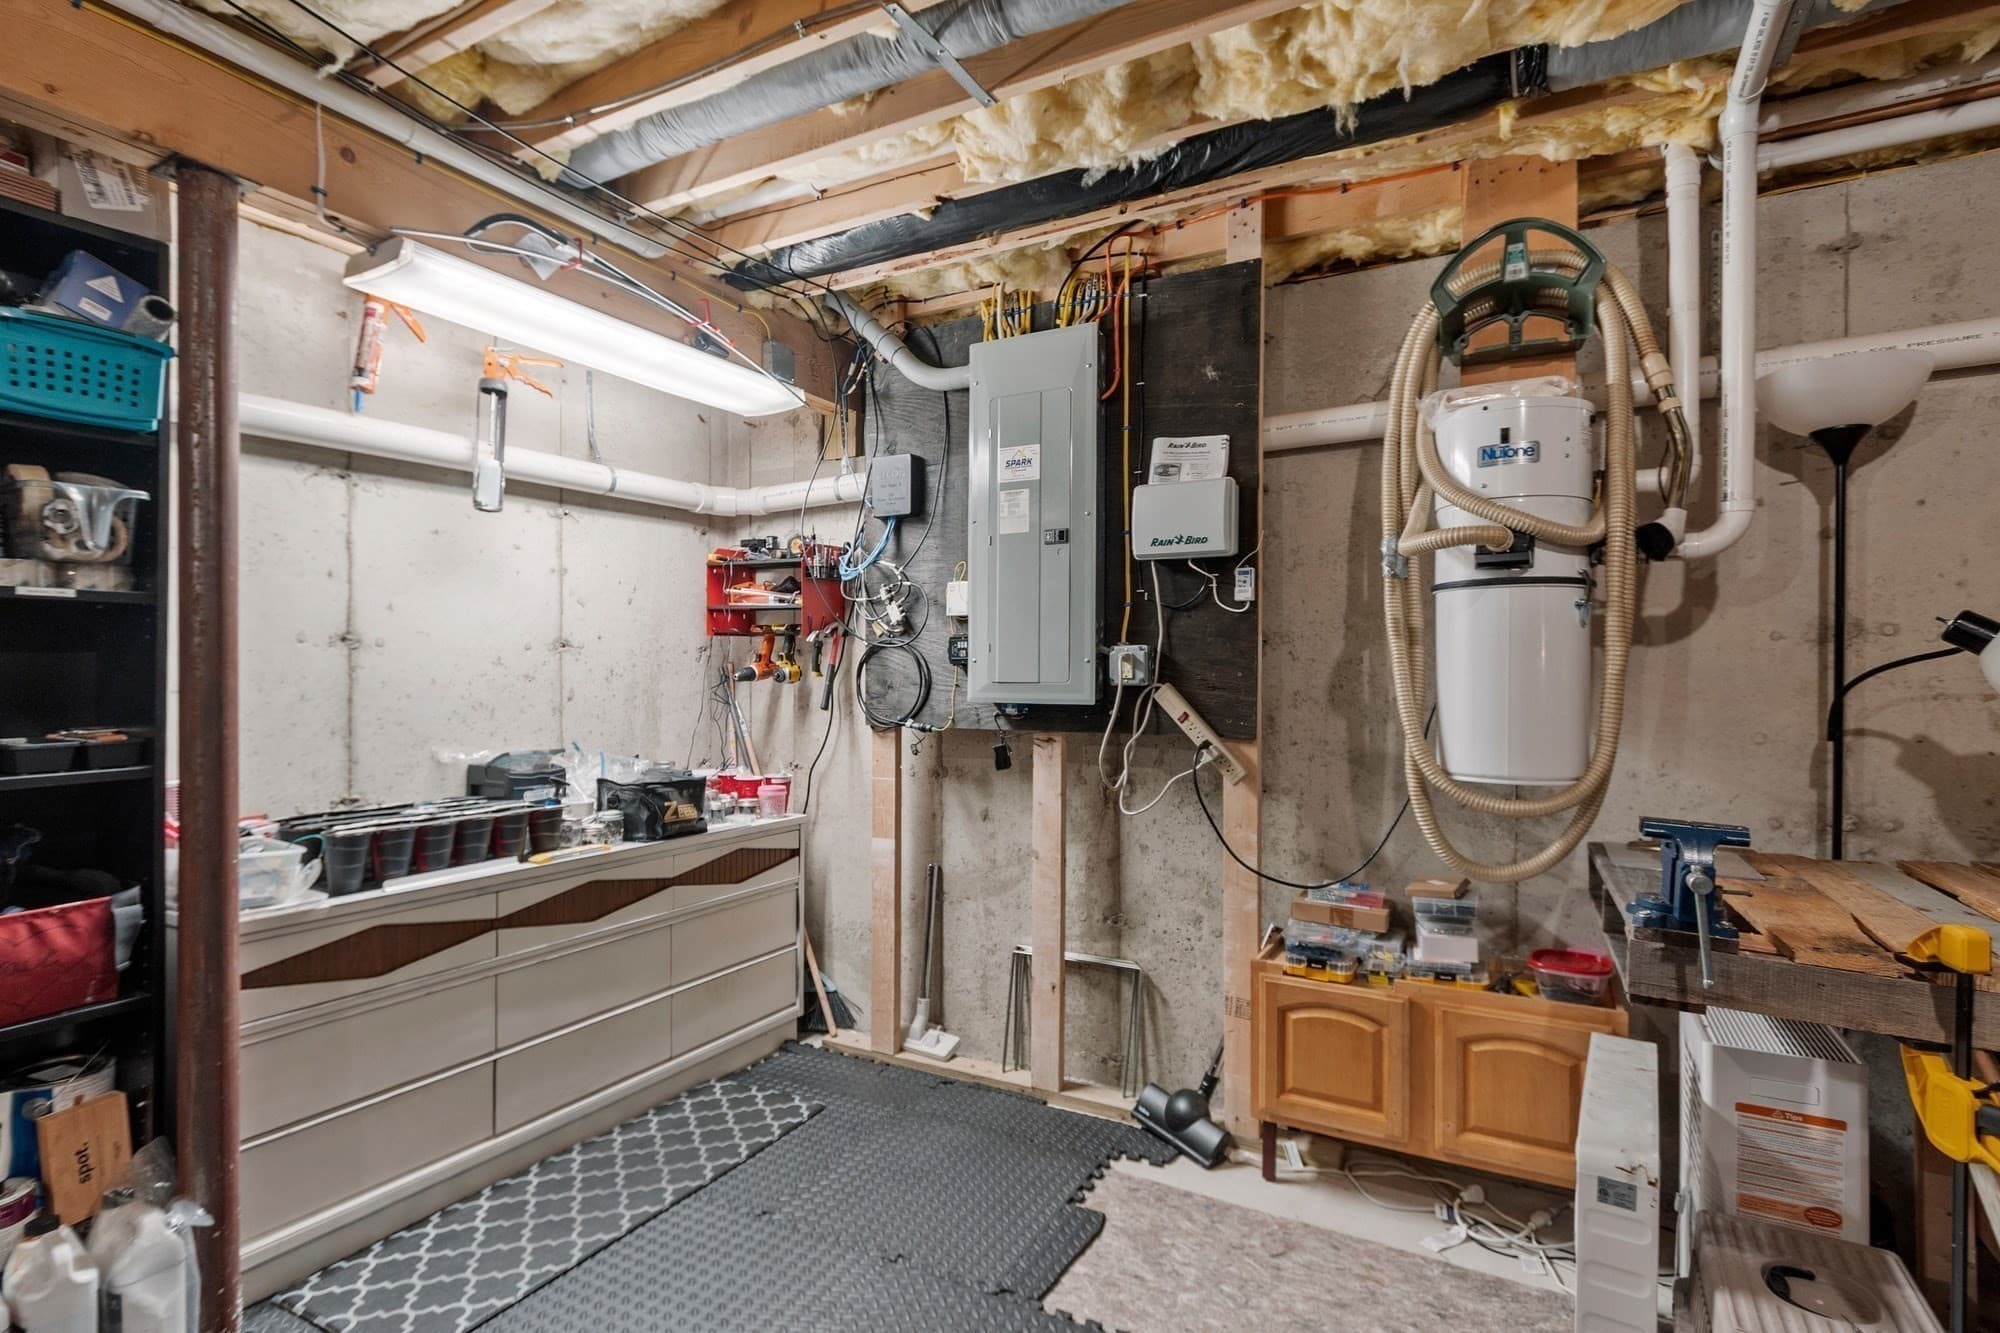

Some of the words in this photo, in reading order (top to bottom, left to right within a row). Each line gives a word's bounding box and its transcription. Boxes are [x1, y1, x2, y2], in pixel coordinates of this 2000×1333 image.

[1906, 333, 1983, 347] PRESSURE
[1481, 445, 1536, 461] NuTone
[1005, 457, 1033, 468] SPARK
[1150, 537, 1175, 547] RAIN
[1184, 535, 1209, 545] BIRD
